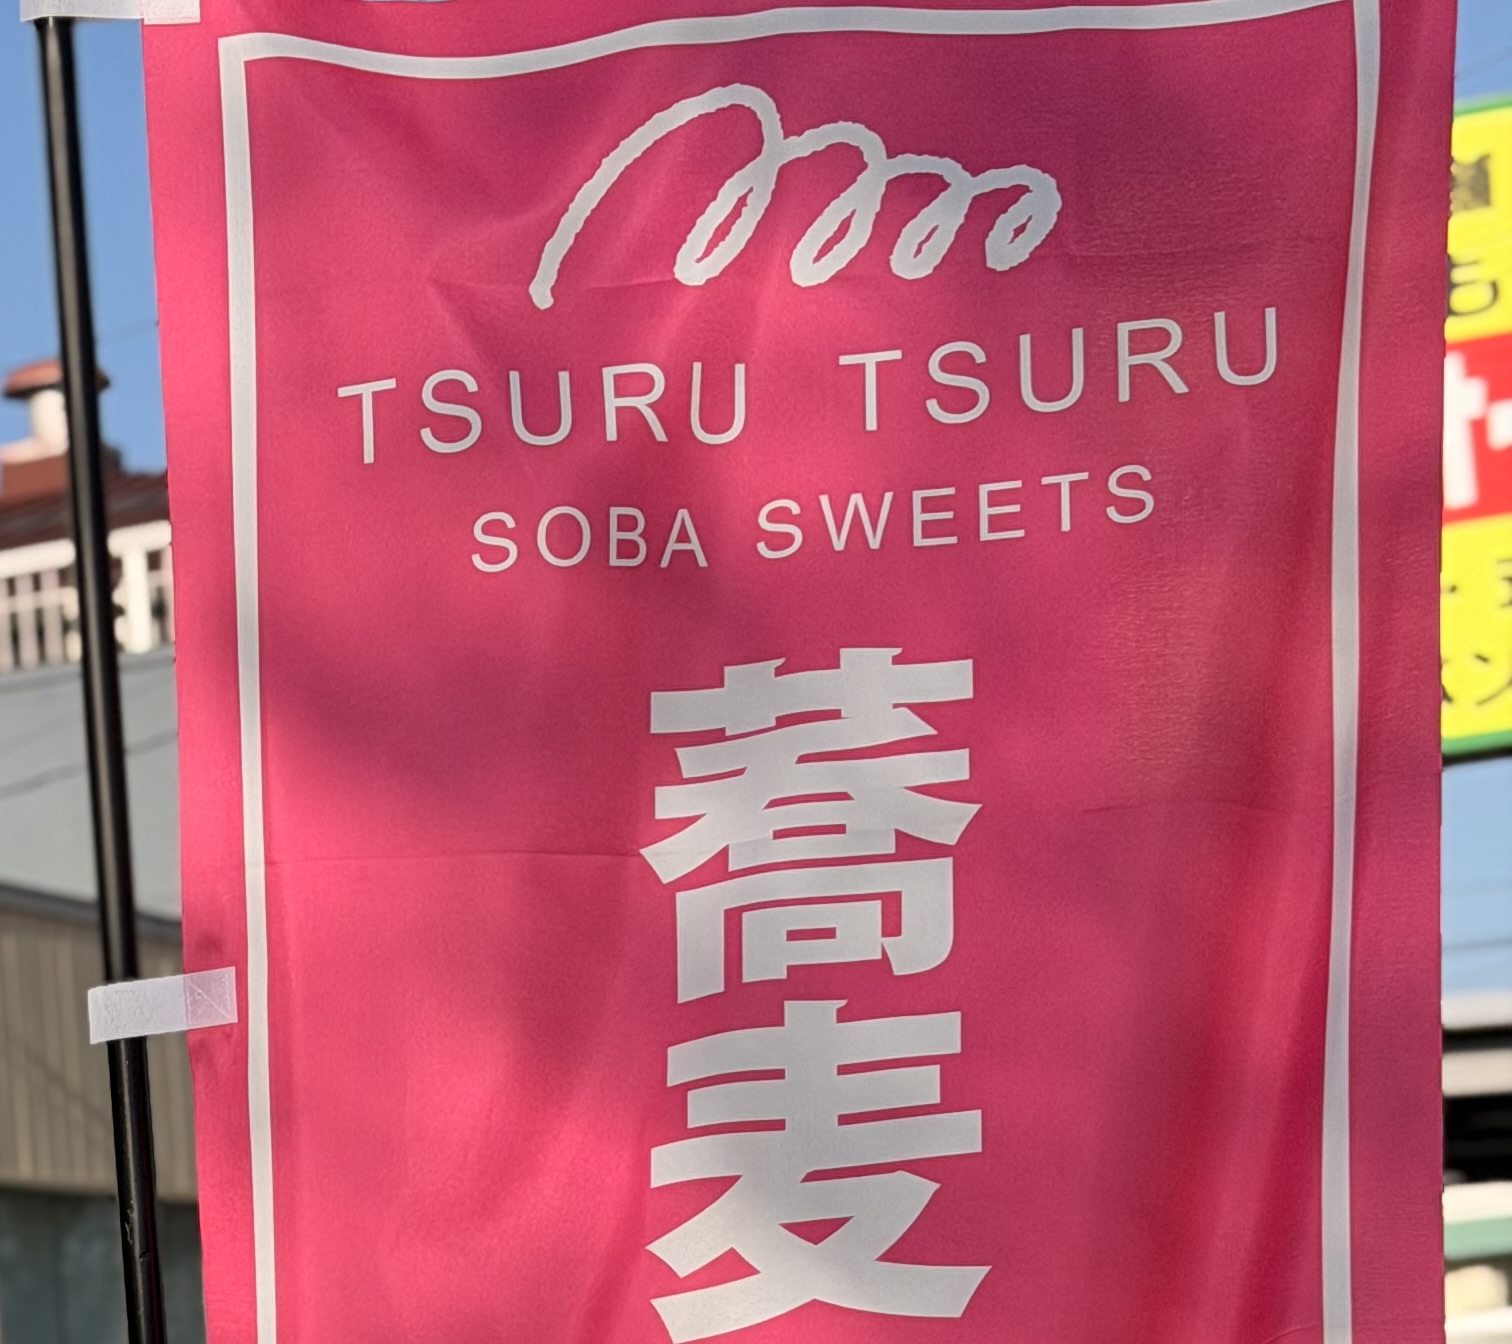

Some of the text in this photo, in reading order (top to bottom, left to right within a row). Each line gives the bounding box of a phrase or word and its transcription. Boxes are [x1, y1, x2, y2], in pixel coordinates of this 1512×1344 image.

[336, 306, 1278, 466] TSURU TSURU
[470, 464, 1156, 573] SOBA SWEETS
